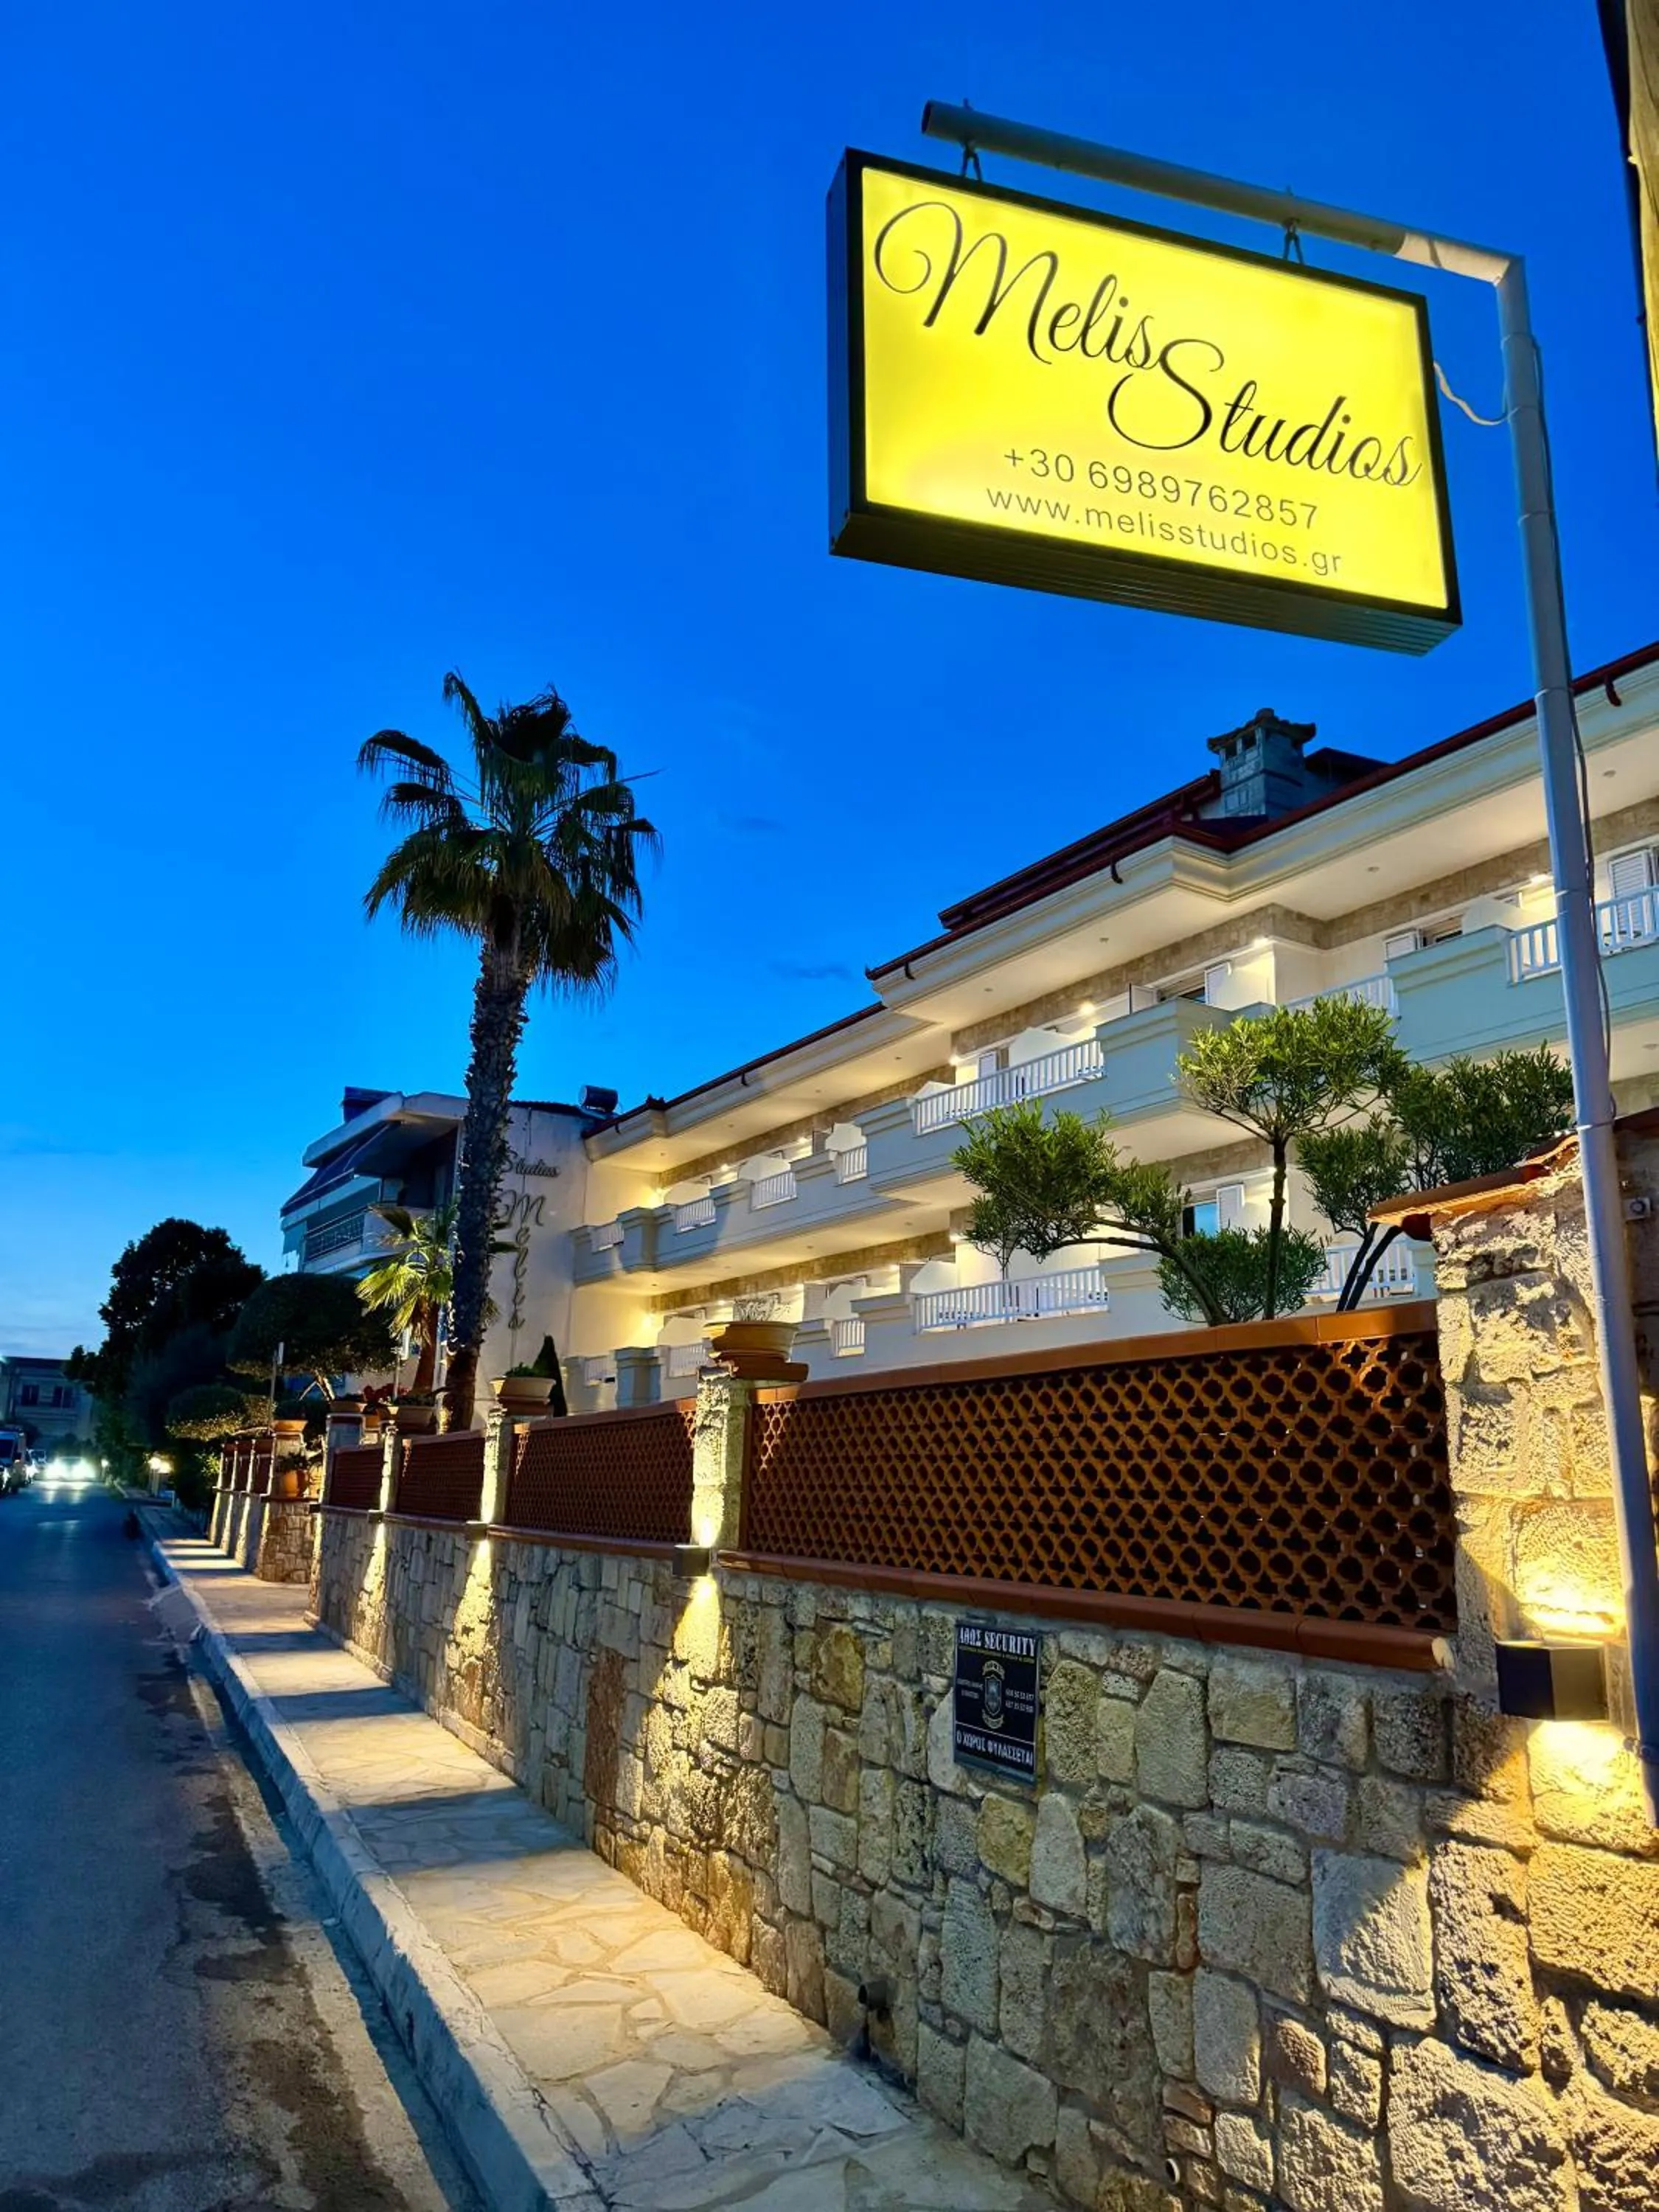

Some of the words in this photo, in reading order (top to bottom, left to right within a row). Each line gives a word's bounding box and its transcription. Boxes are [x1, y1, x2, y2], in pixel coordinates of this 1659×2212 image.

[874, 201, 1158, 370] Melis
[1108, 338, 1422, 487] Studios
[987, 485, 1343, 576] www.melisstudios.gr
[1004, 447, 1075, 483] +30
[1089, 461, 1318, 529] 6989762857
[984, 1630, 1036, 1657] SECURITY
